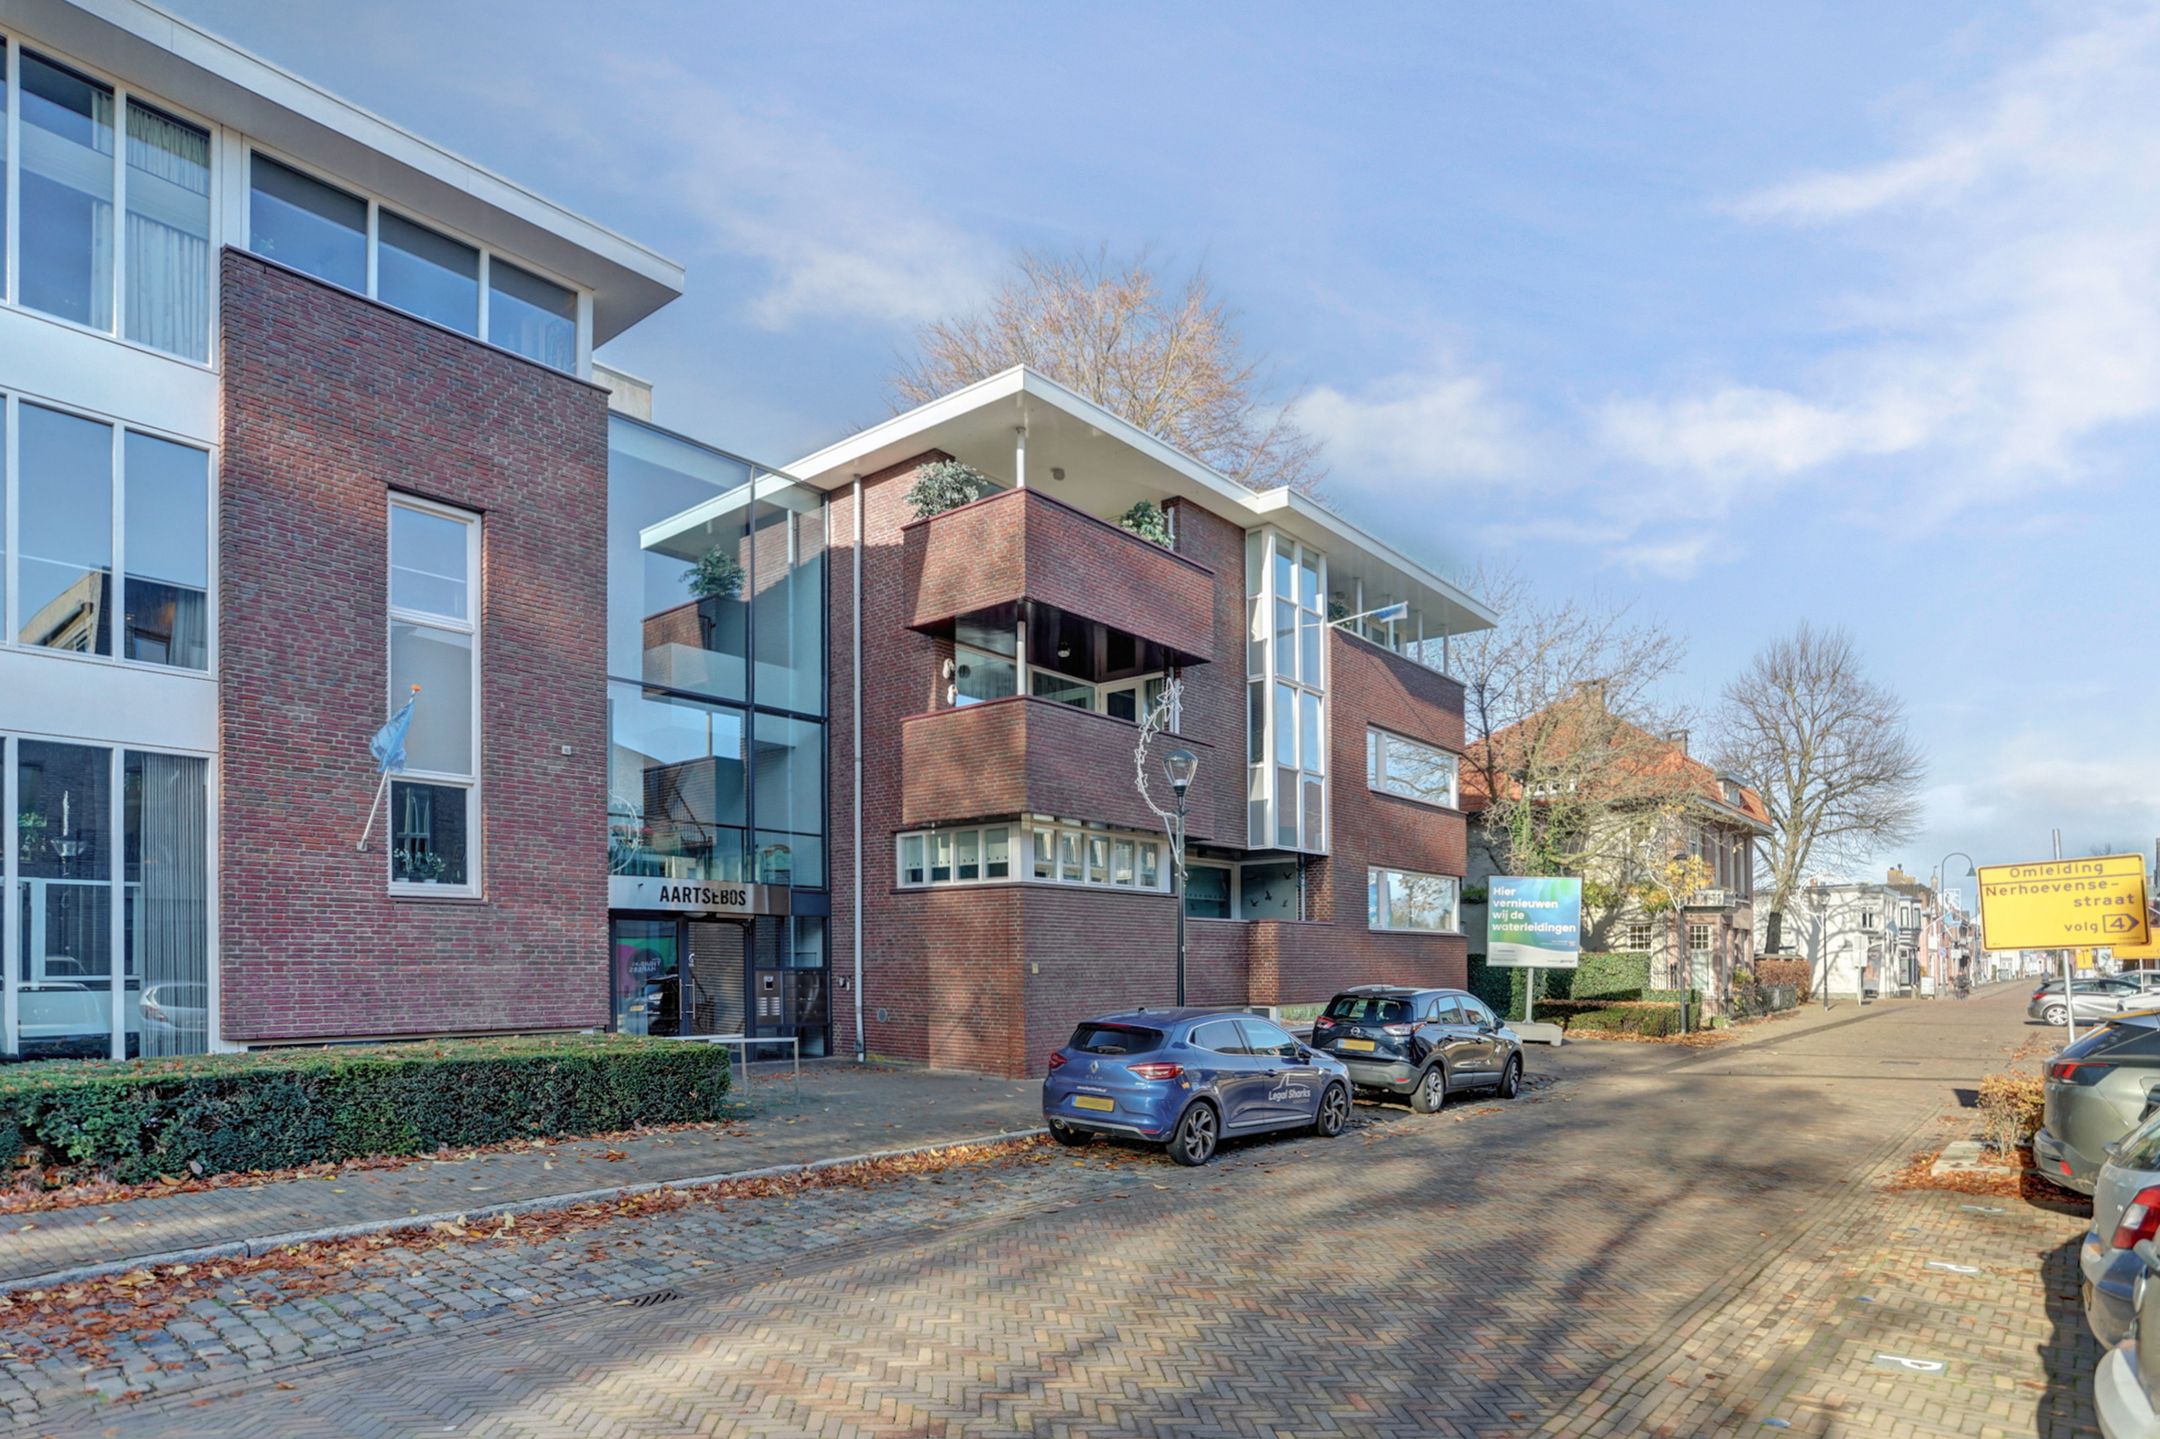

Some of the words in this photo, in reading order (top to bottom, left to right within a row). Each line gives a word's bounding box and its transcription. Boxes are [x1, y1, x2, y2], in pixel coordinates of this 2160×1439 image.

[2009, 863, 2104, 879] Omleiding
[1493, 886, 1516, 896] Hier
[1492, 898, 1559, 909] vernieuwen
[2073, 893, 2135, 908] straat
[1492, 910, 1508, 921] wij
[1510, 910, 1525, 920] de
[1492, 922, 1576, 935] waterleidingen
[2063, 921, 2099, 934] volg
[2109, 916, 2126, 930] 4
[1268, 1089, 1287, 1102] Legal
